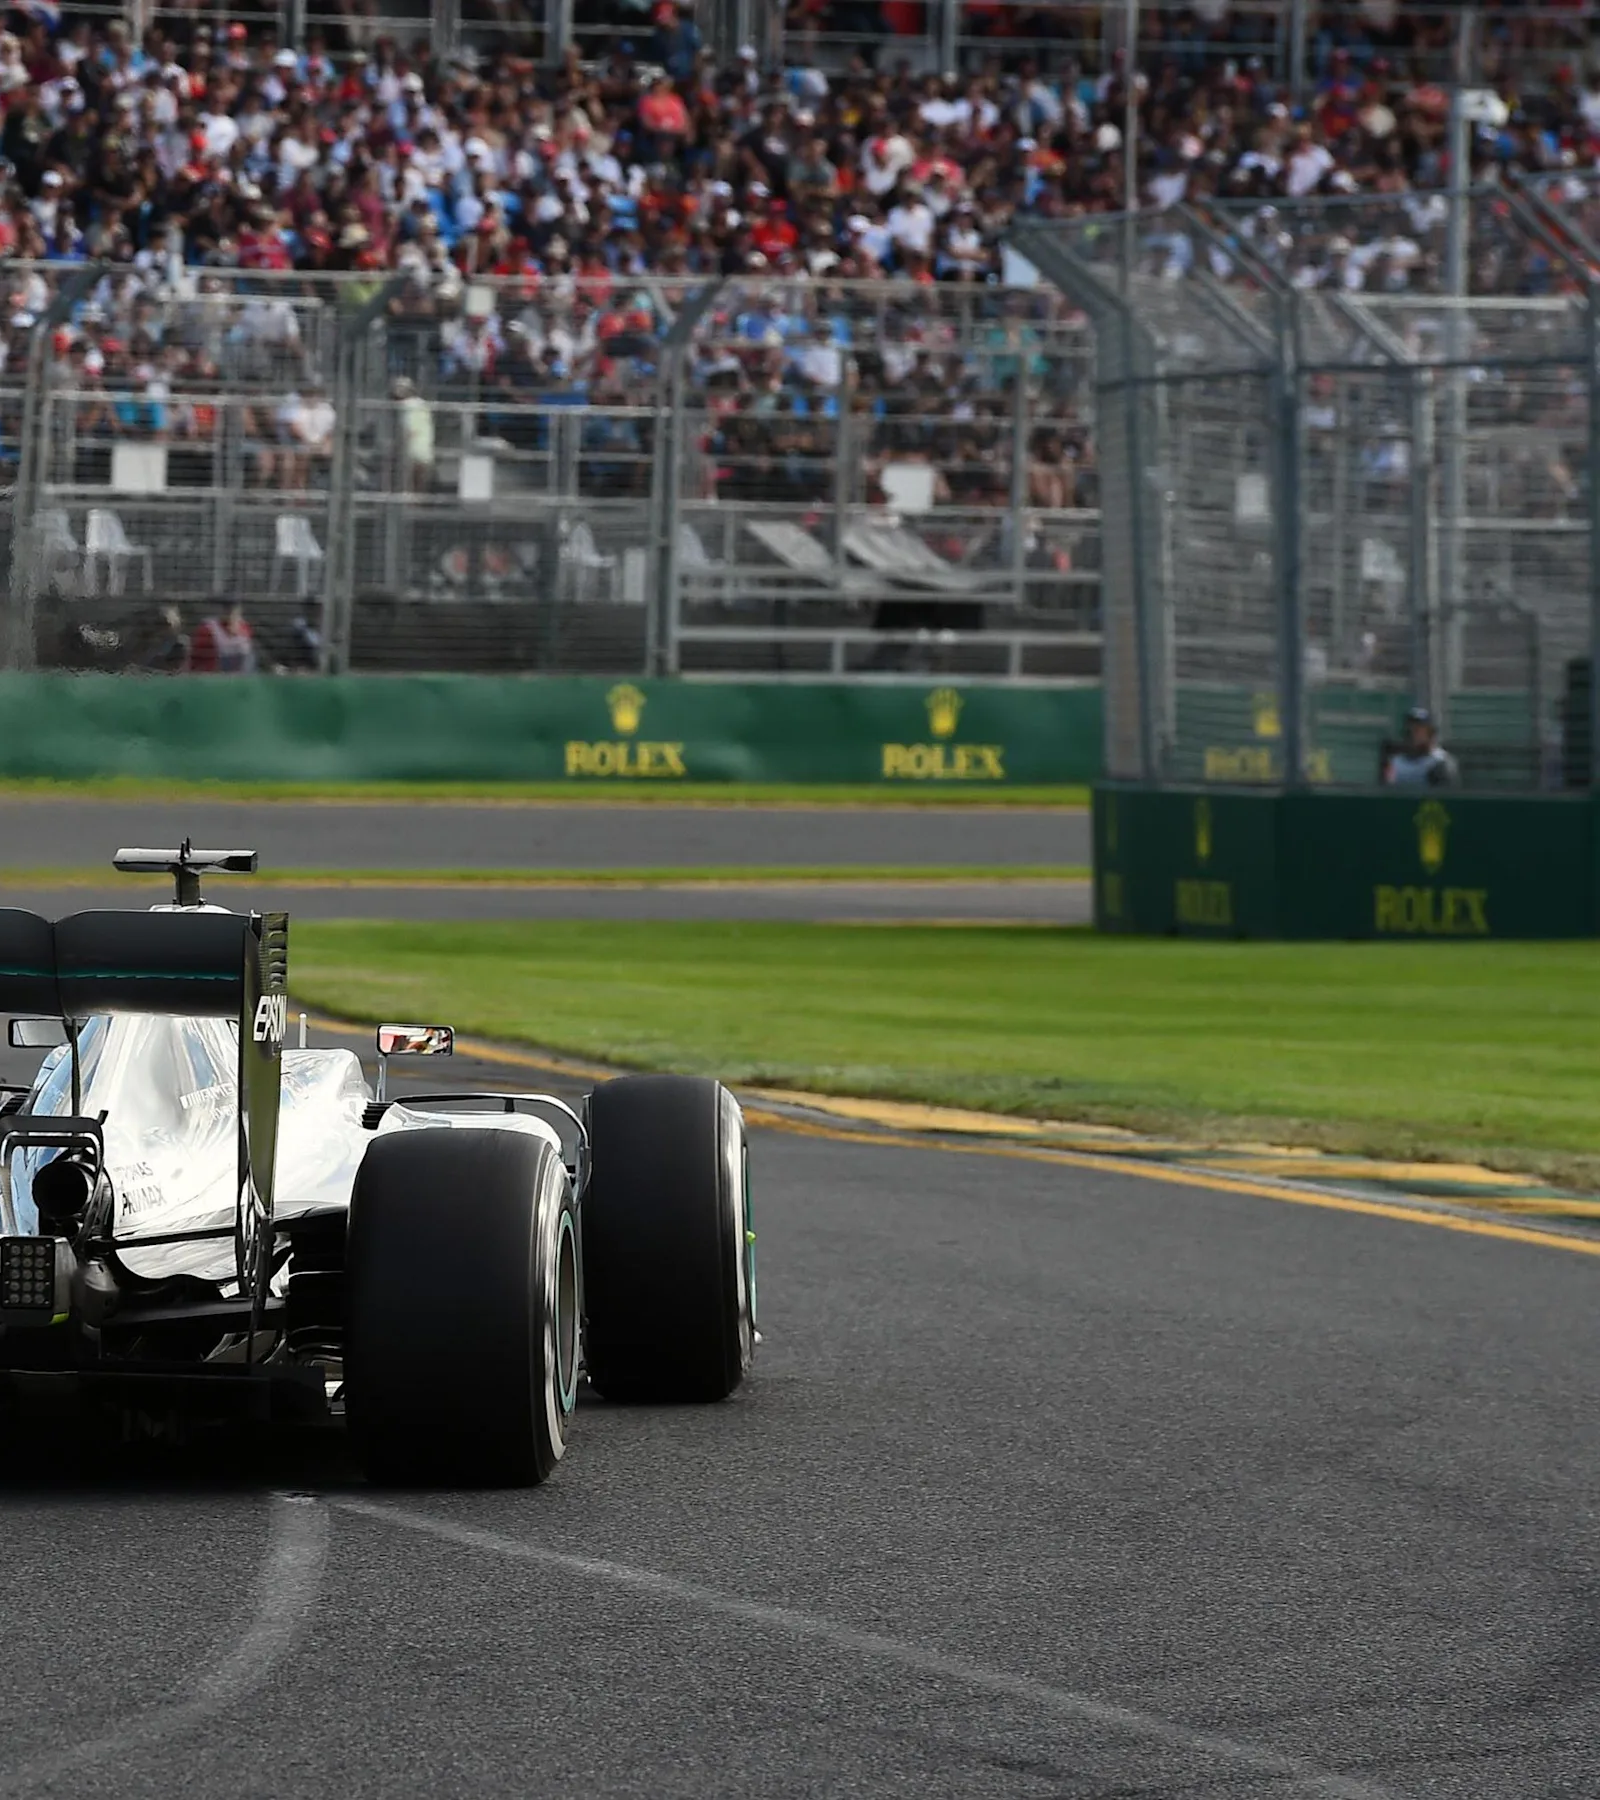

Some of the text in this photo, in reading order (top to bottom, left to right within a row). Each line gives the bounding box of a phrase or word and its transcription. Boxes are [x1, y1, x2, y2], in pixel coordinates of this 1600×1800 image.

[566, 741, 686, 776] ROLEX
[882, 744, 1004, 778] ROLEX
[1375, 884, 1489, 933] ROLEX
[253, 994, 287, 1042] EPSON
